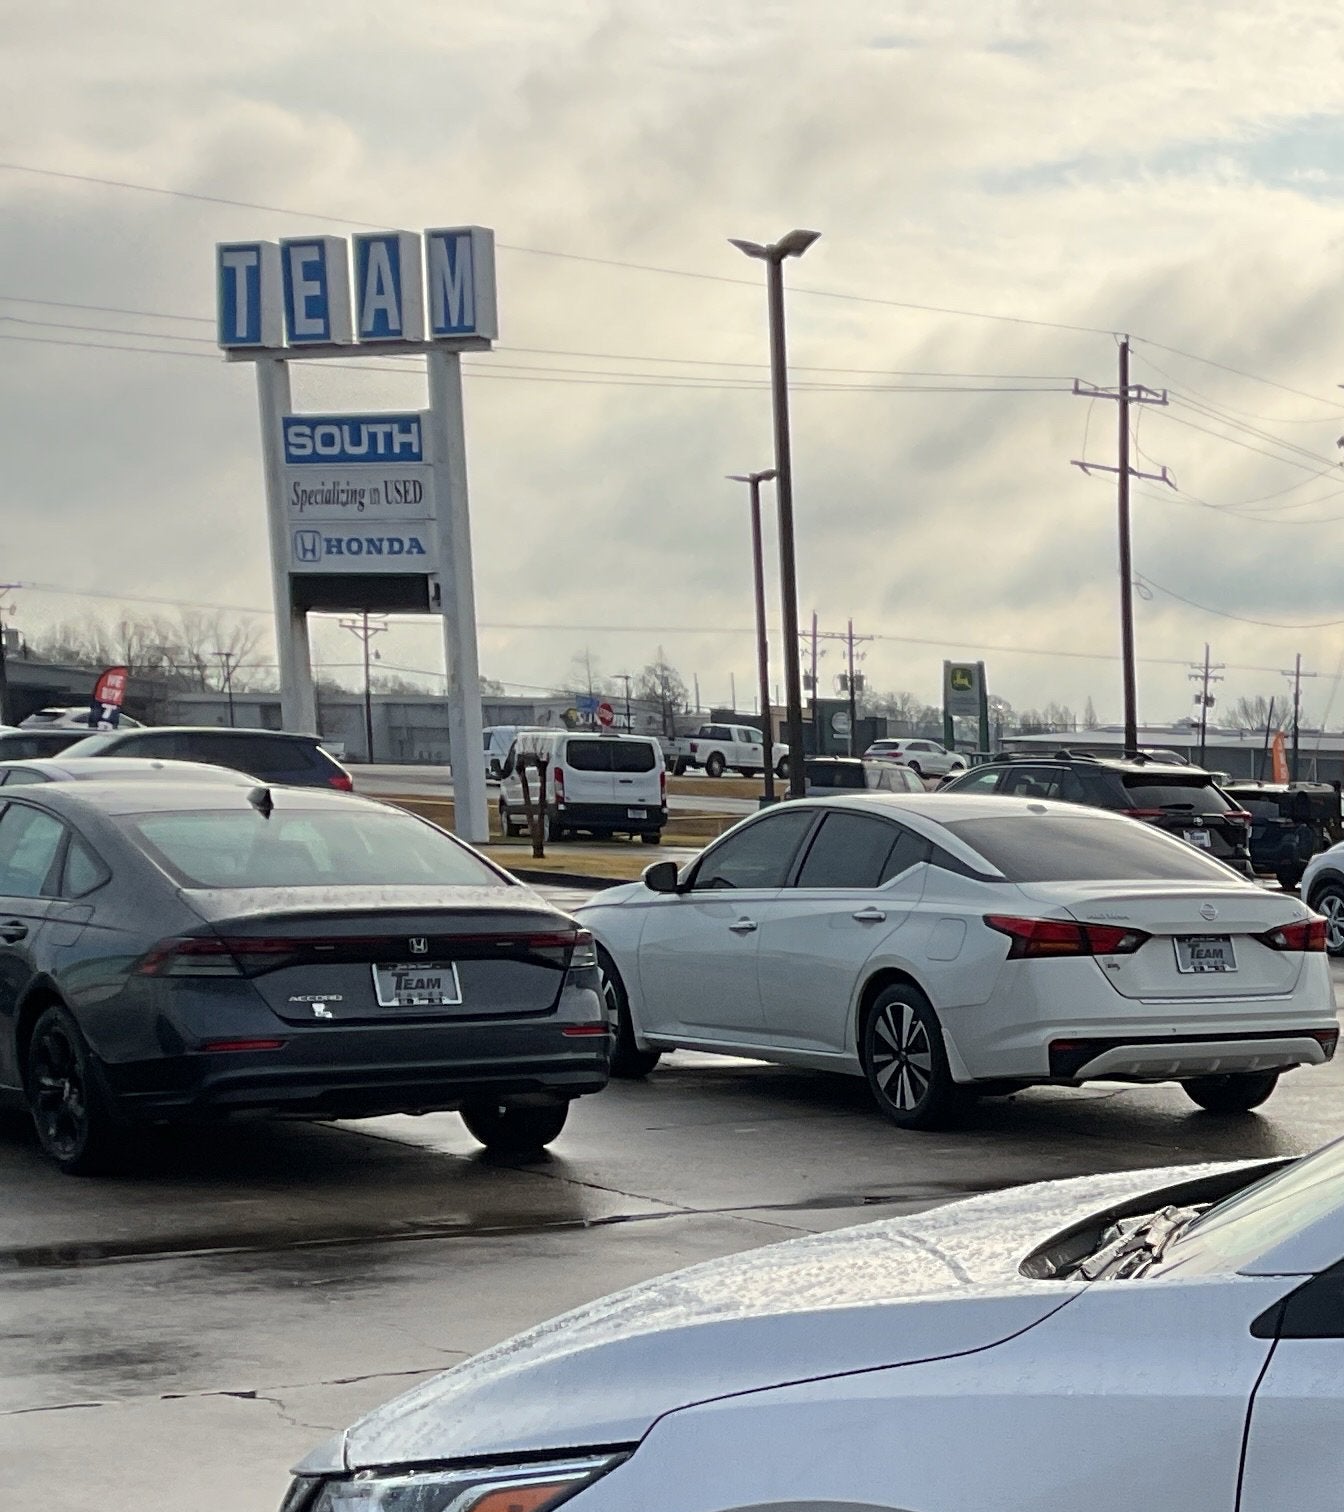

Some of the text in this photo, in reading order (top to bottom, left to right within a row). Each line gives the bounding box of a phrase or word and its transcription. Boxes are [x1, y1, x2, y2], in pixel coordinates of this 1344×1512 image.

[222, 237, 474, 338] TEAM
[286, 422, 419, 456] SOUTH
[291, 479, 423, 512] Specializing in USED
[323, 537, 426, 556] HONDA
[391, 972, 441, 990] TEAM
[288, 994, 342, 1002] ACCORD
